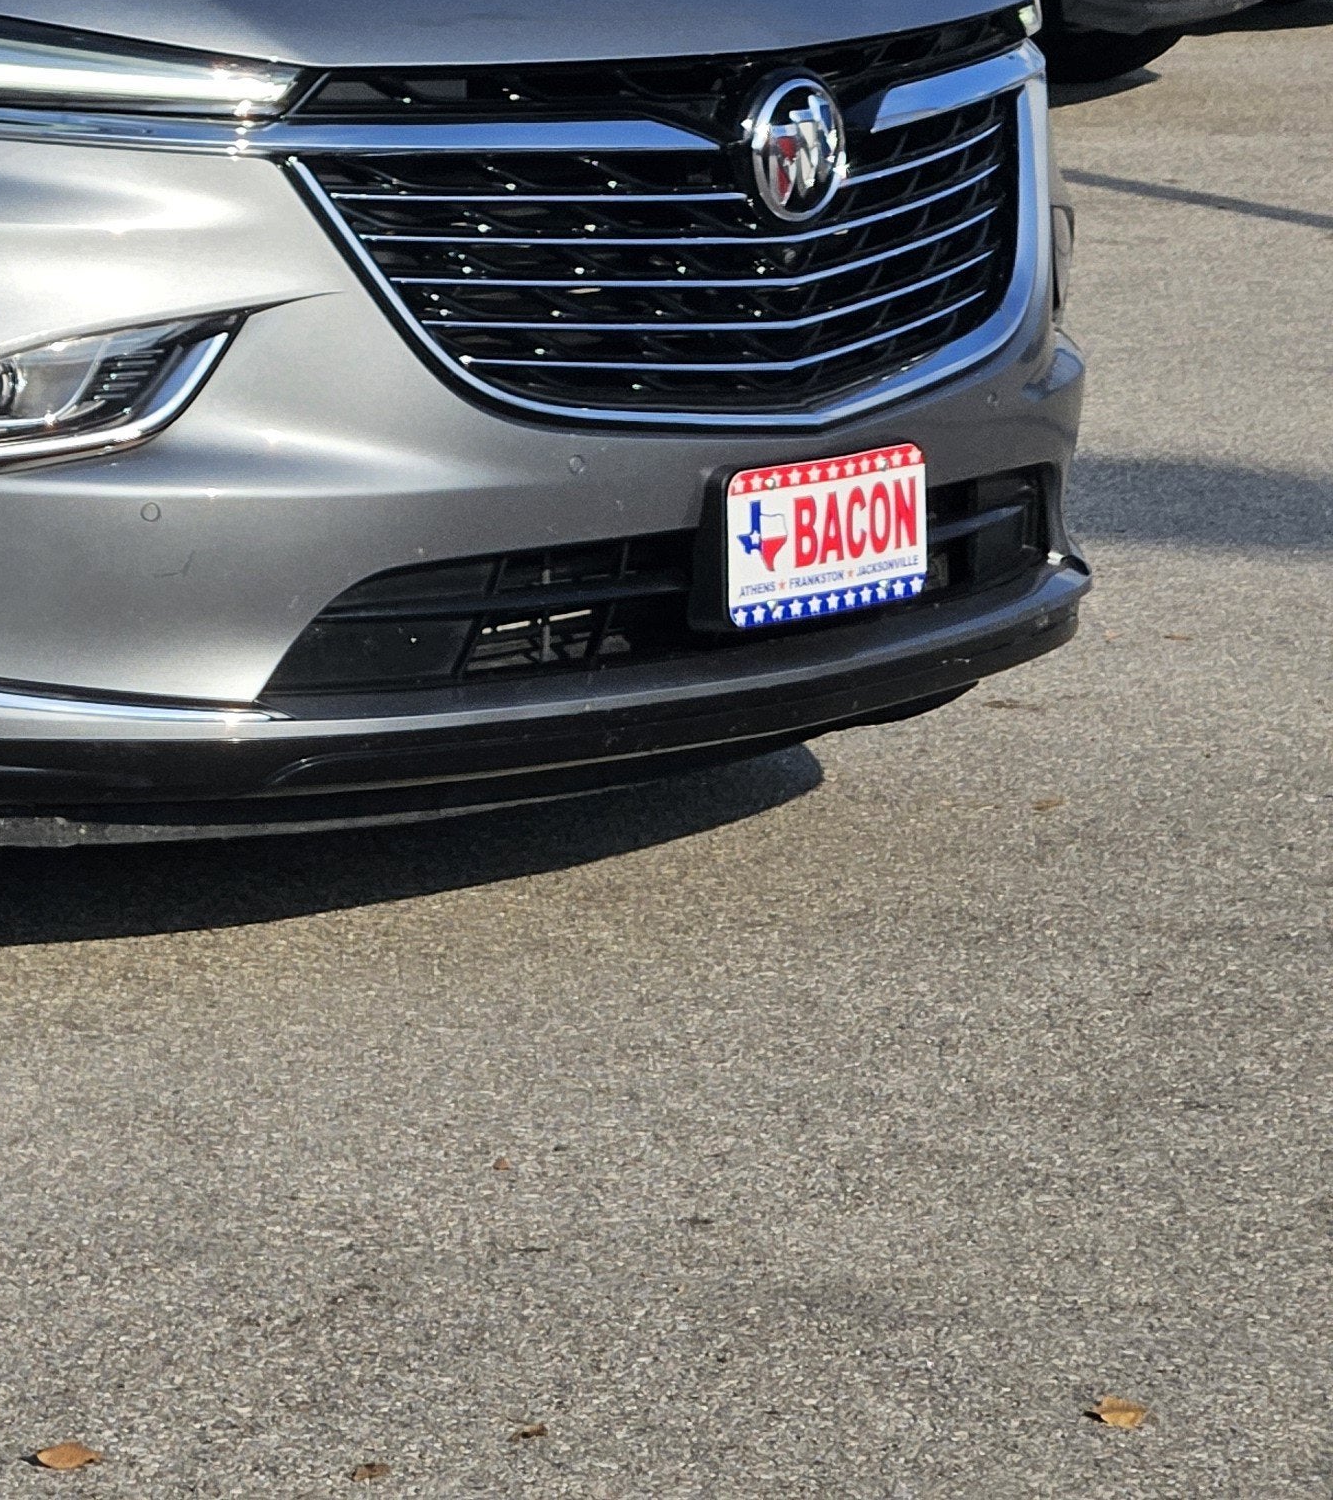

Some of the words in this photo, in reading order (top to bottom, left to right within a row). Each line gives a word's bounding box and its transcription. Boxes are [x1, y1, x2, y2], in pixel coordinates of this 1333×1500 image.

[793, 475, 918, 569] BACON
[738, 581, 777, 599] ATHENS
[788, 569, 845, 590] FRANKSTON
[856, 554, 920, 577] JACKSONVILLE
